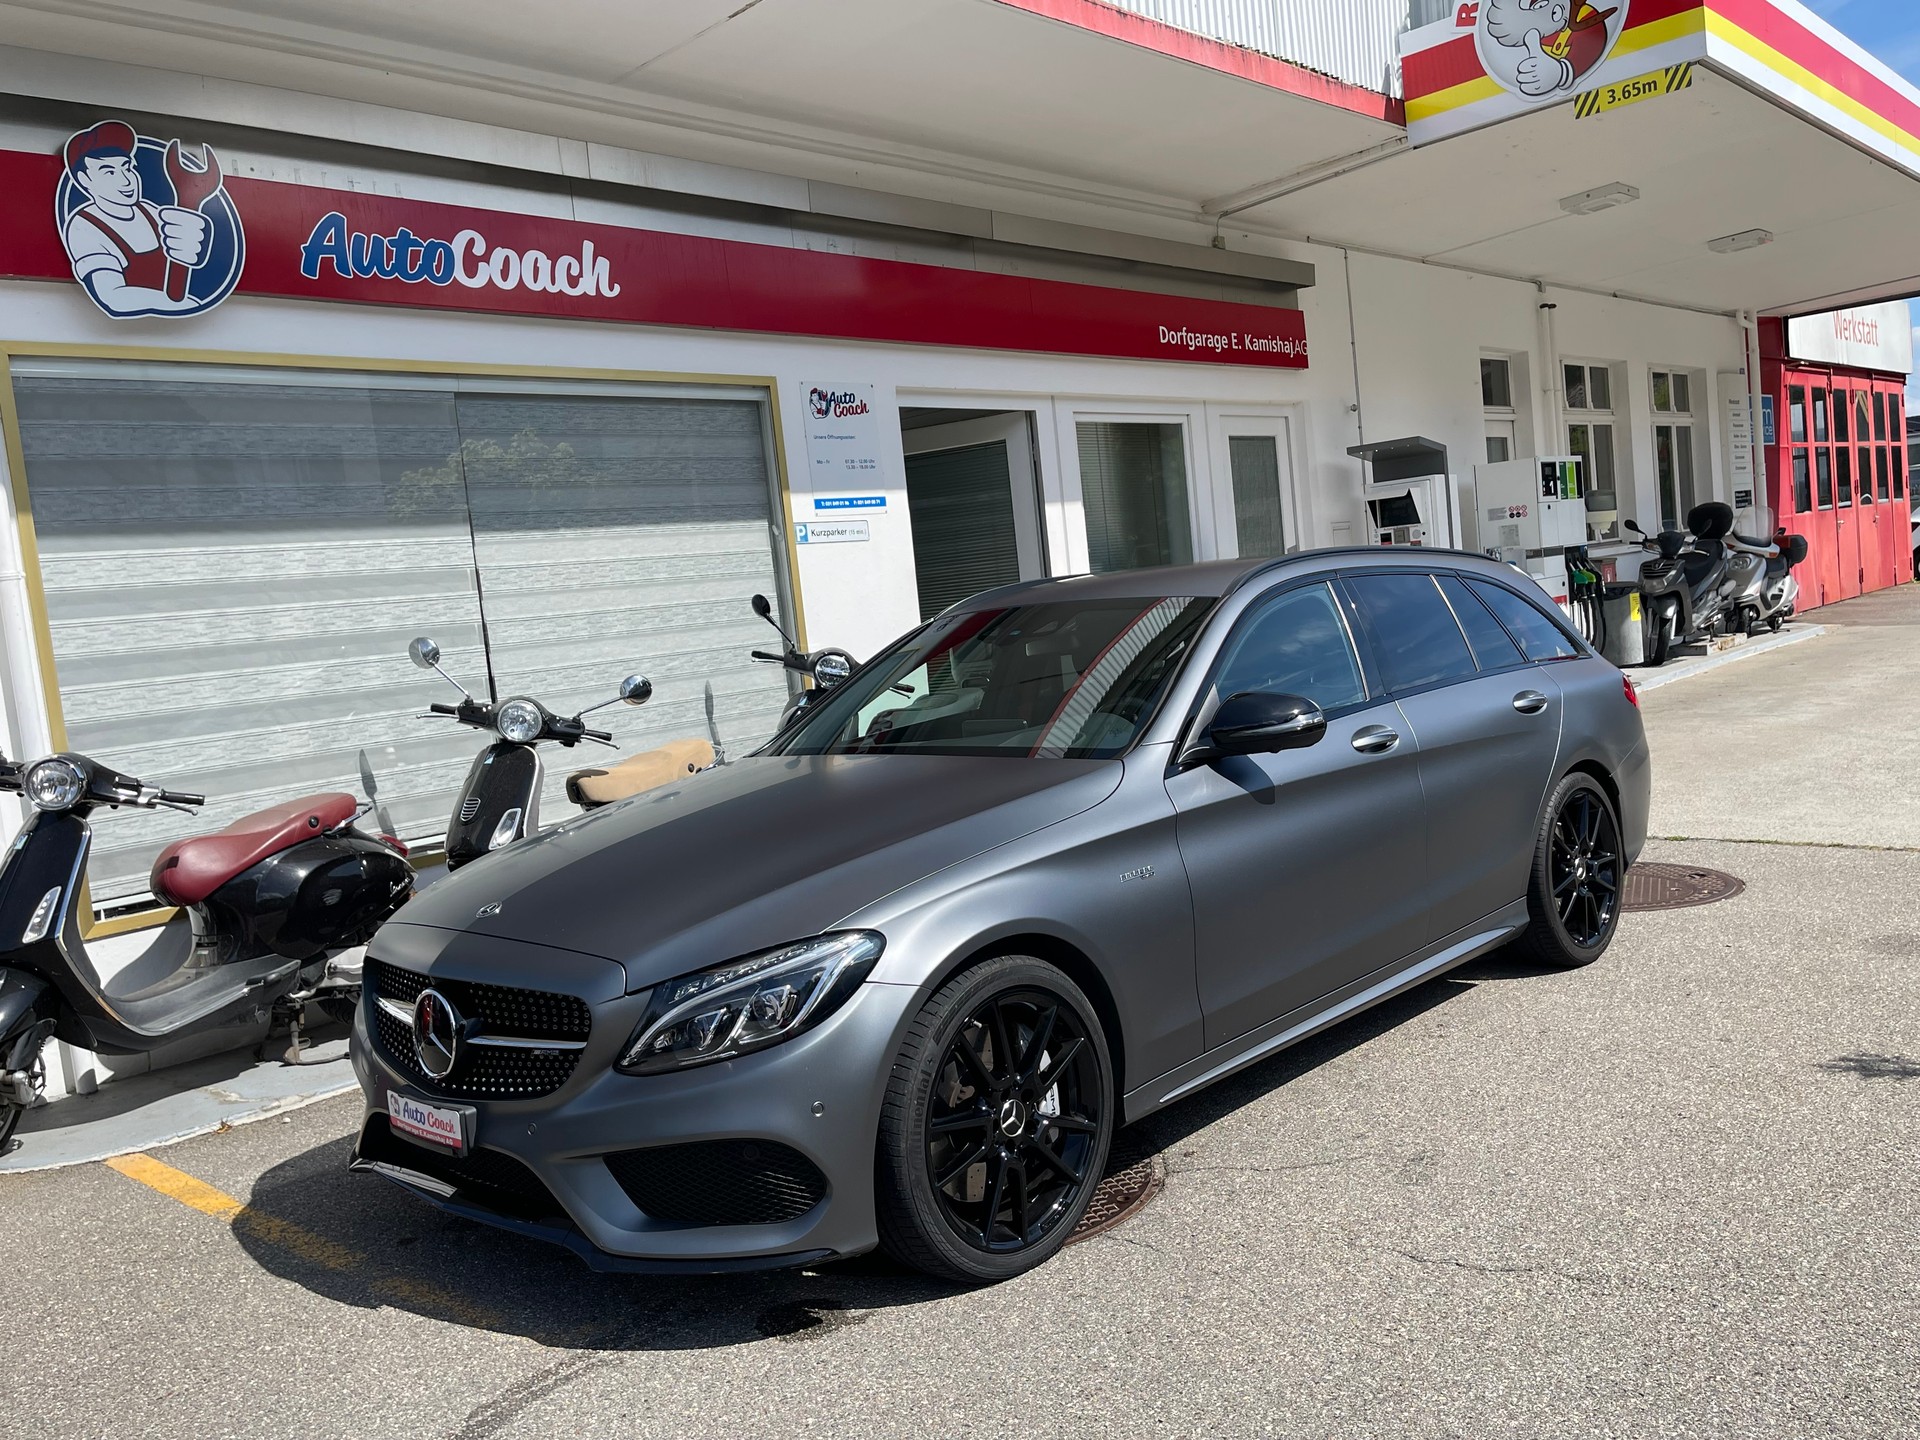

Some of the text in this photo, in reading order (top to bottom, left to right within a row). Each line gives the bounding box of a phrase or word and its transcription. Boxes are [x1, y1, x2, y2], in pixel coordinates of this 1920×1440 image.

[1606, 79, 1658, 104] 3.65m
[1158, 325, 1229, 352] Dorfgarage
[1231, 332, 1242, 350] E.
[1832, 309, 1879, 347] Werkstatt
[829, 391, 856, 408] Auto
[834, 399, 870, 418] Coach
[810, 528, 848, 538] Kurzparker
[402, 1100, 455, 1134] Auto Coach
